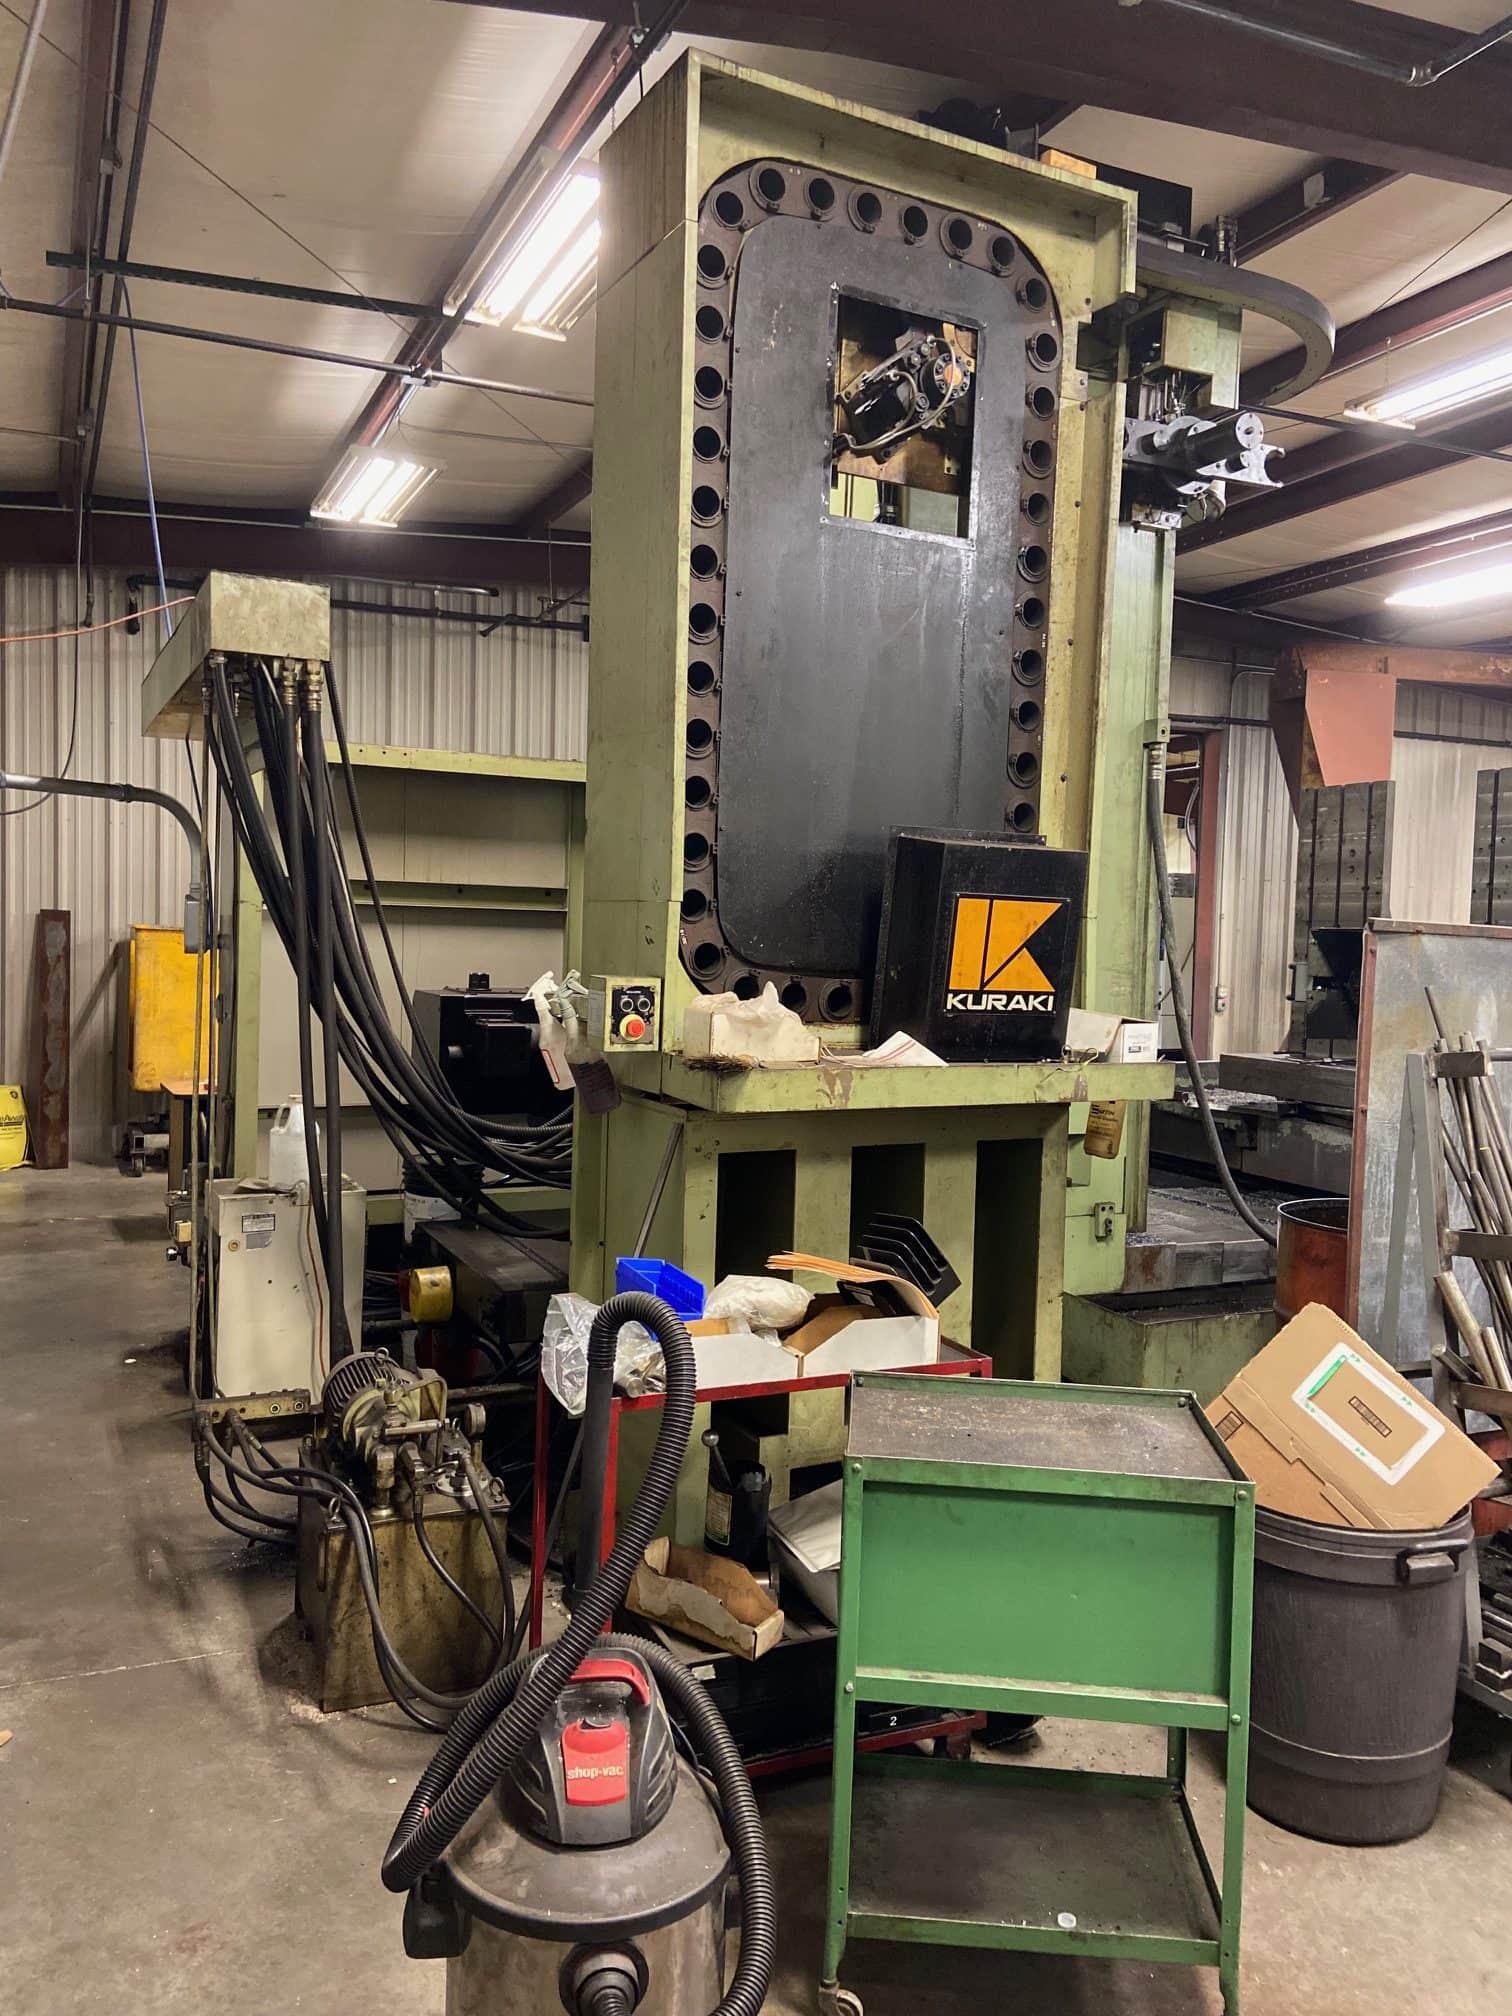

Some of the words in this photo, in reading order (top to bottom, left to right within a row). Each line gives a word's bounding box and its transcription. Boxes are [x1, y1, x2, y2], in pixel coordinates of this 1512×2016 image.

[946, 993, 1054, 1011] KURAKI
[890, 1716, 897, 1726] 2
[567, 1766, 625, 1779] shop-vac
